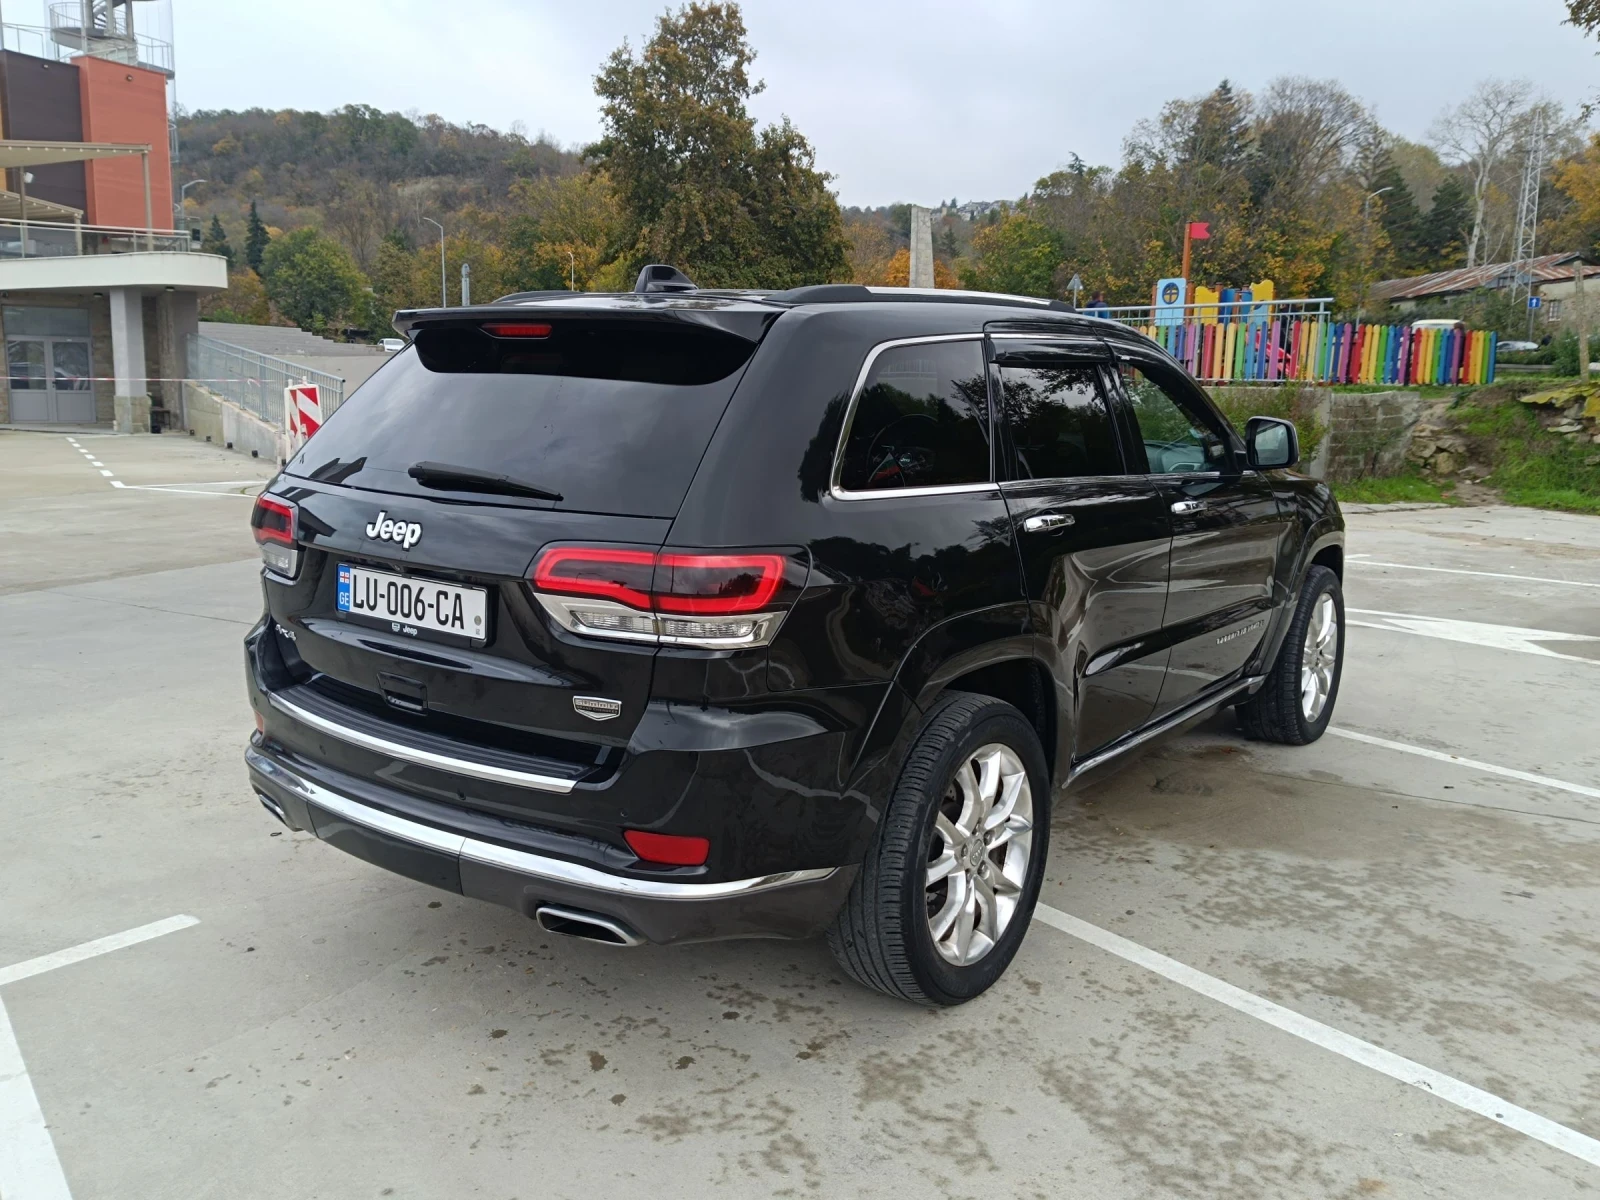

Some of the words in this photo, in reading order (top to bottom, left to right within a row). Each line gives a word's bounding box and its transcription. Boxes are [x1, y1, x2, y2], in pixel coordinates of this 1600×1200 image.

[365, 511, 422, 550] Jeep
[339, 592, 350, 606] GE
[353, 574, 465, 630] LU-006-CA
[402, 625, 418, 636] Jeep
